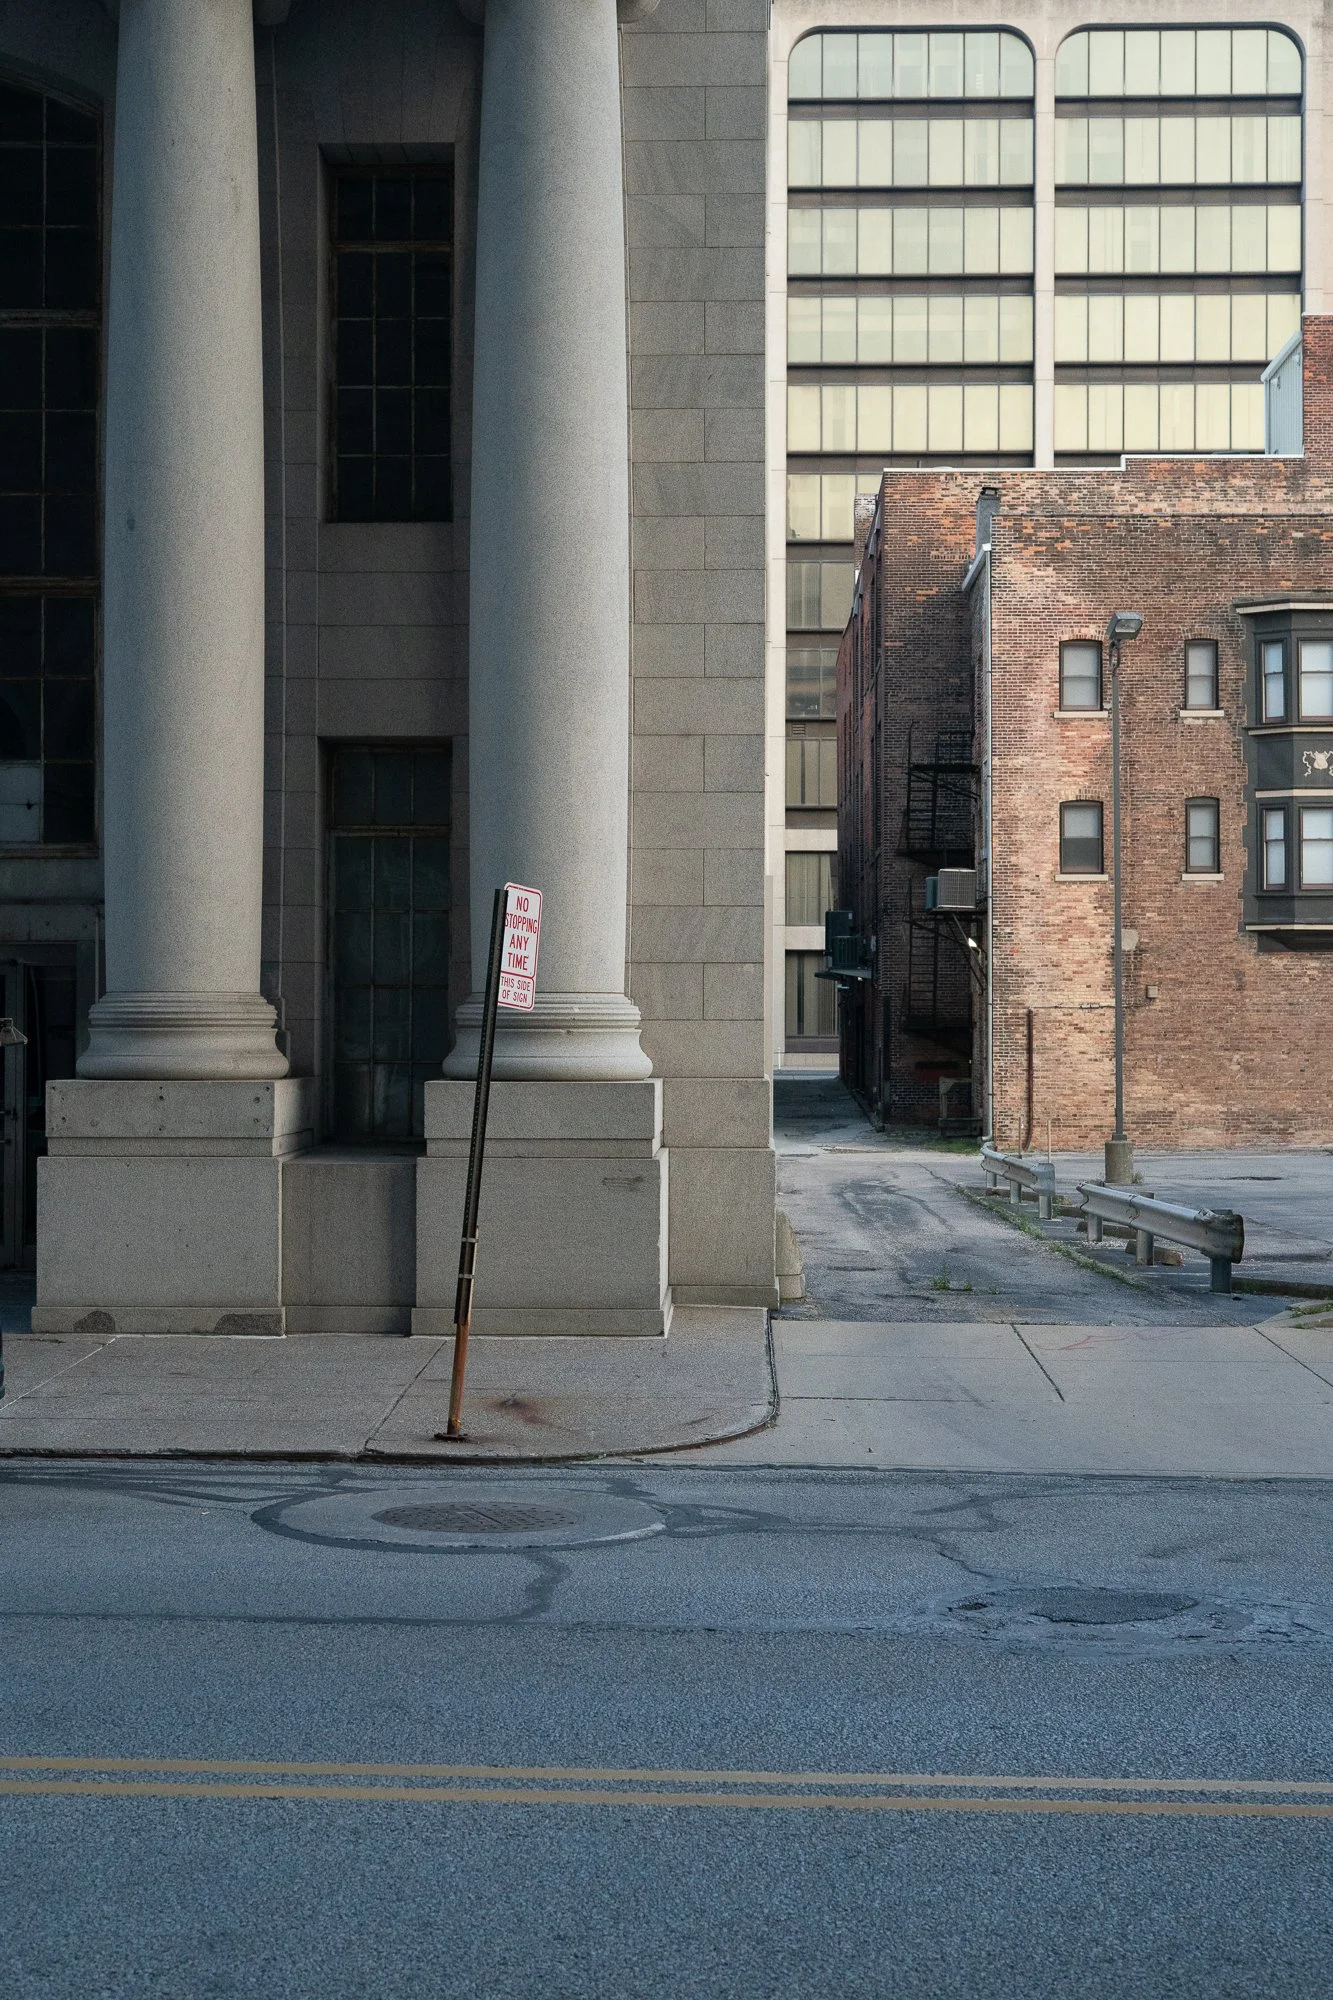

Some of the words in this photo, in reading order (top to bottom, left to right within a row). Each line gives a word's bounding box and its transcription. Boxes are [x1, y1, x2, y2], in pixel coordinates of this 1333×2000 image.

[516, 895, 529, 912] NO
[505, 912, 538, 934] STOPPING
[510, 933, 529, 951] ANY
[507, 952, 529, 971] TIME
[501, 976, 515, 989] THIS
[517, 979, 531, 992] SIDE
[502, 989, 511, 1000] OF
[513, 991, 528, 1003] SIGN
